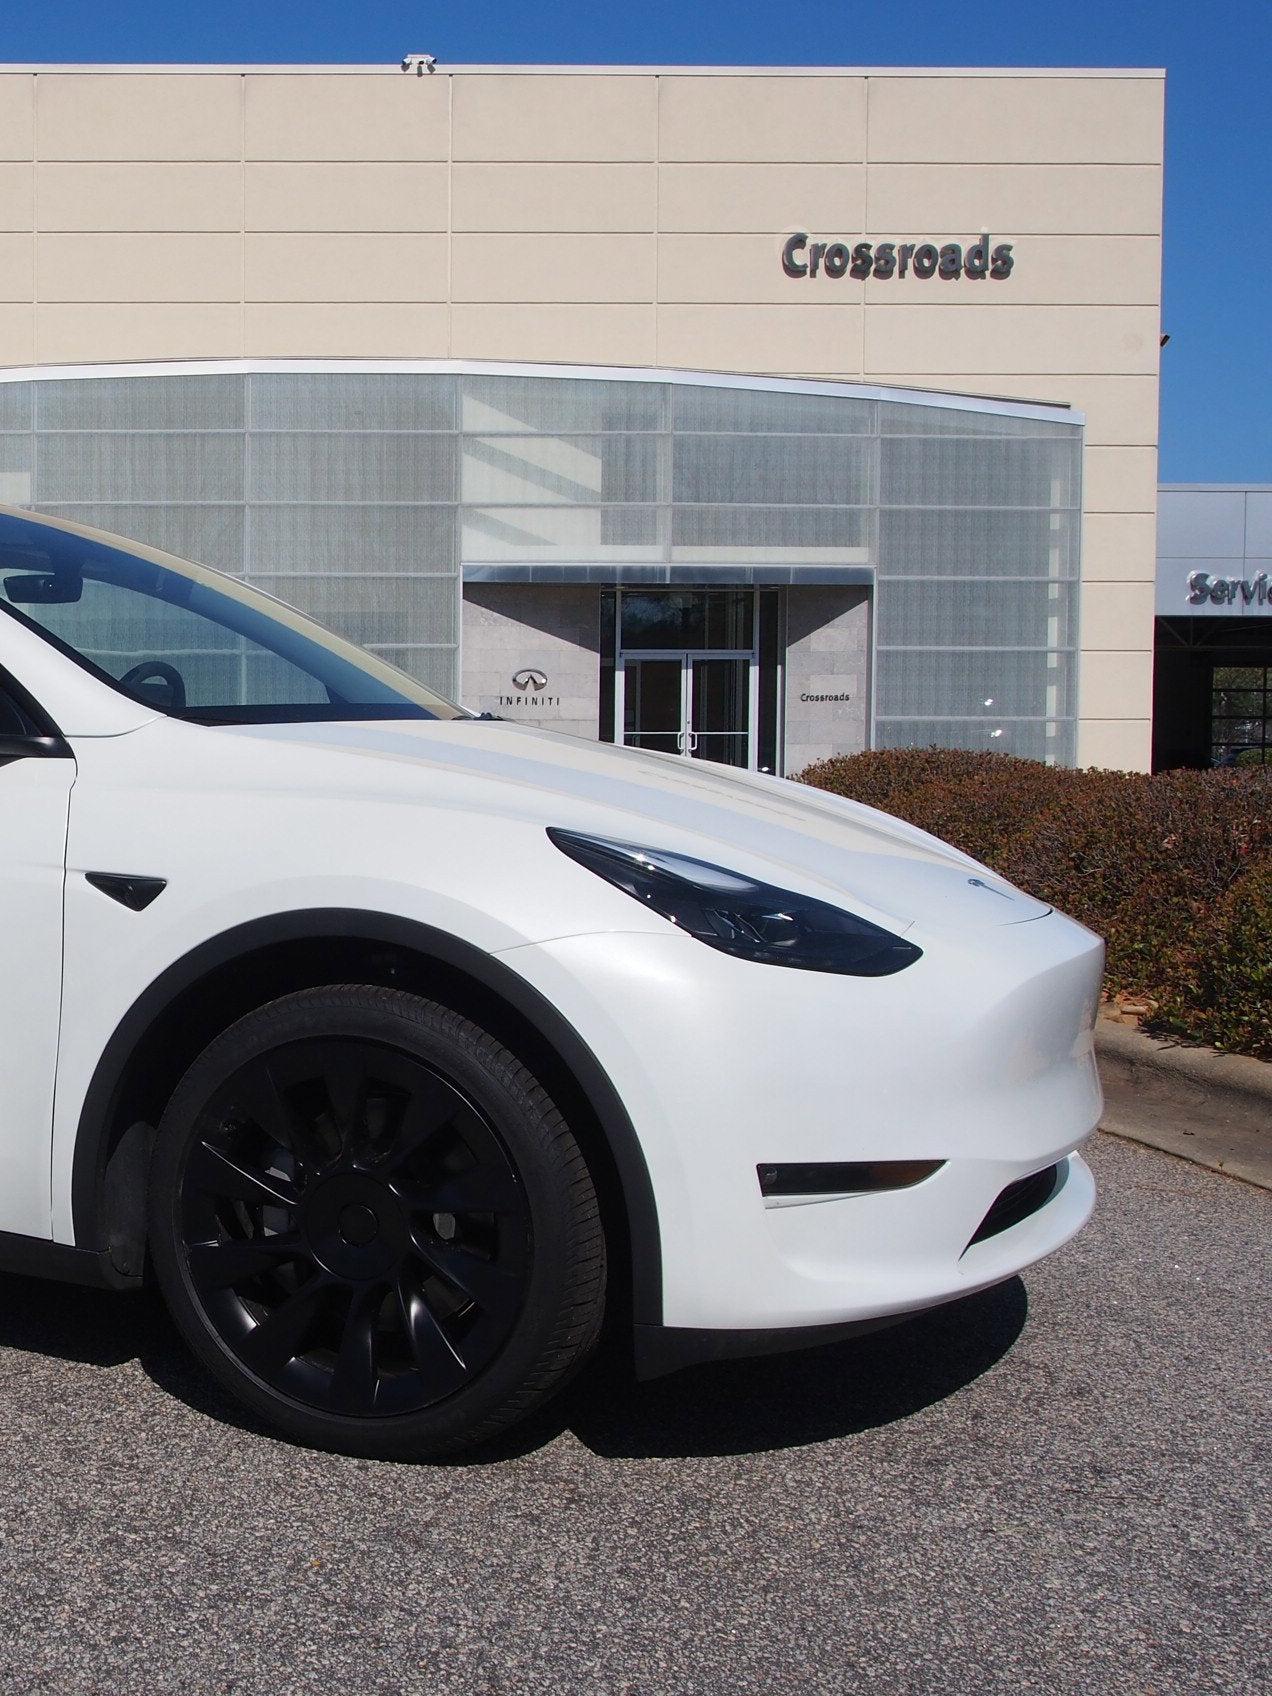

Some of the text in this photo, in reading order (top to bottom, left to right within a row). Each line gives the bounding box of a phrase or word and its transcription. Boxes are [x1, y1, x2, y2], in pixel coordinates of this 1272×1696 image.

[781, 232, 1015, 280] Crossroads
[500, 696, 560, 706] INFINITI
[800, 692, 850, 702] Crossroads
